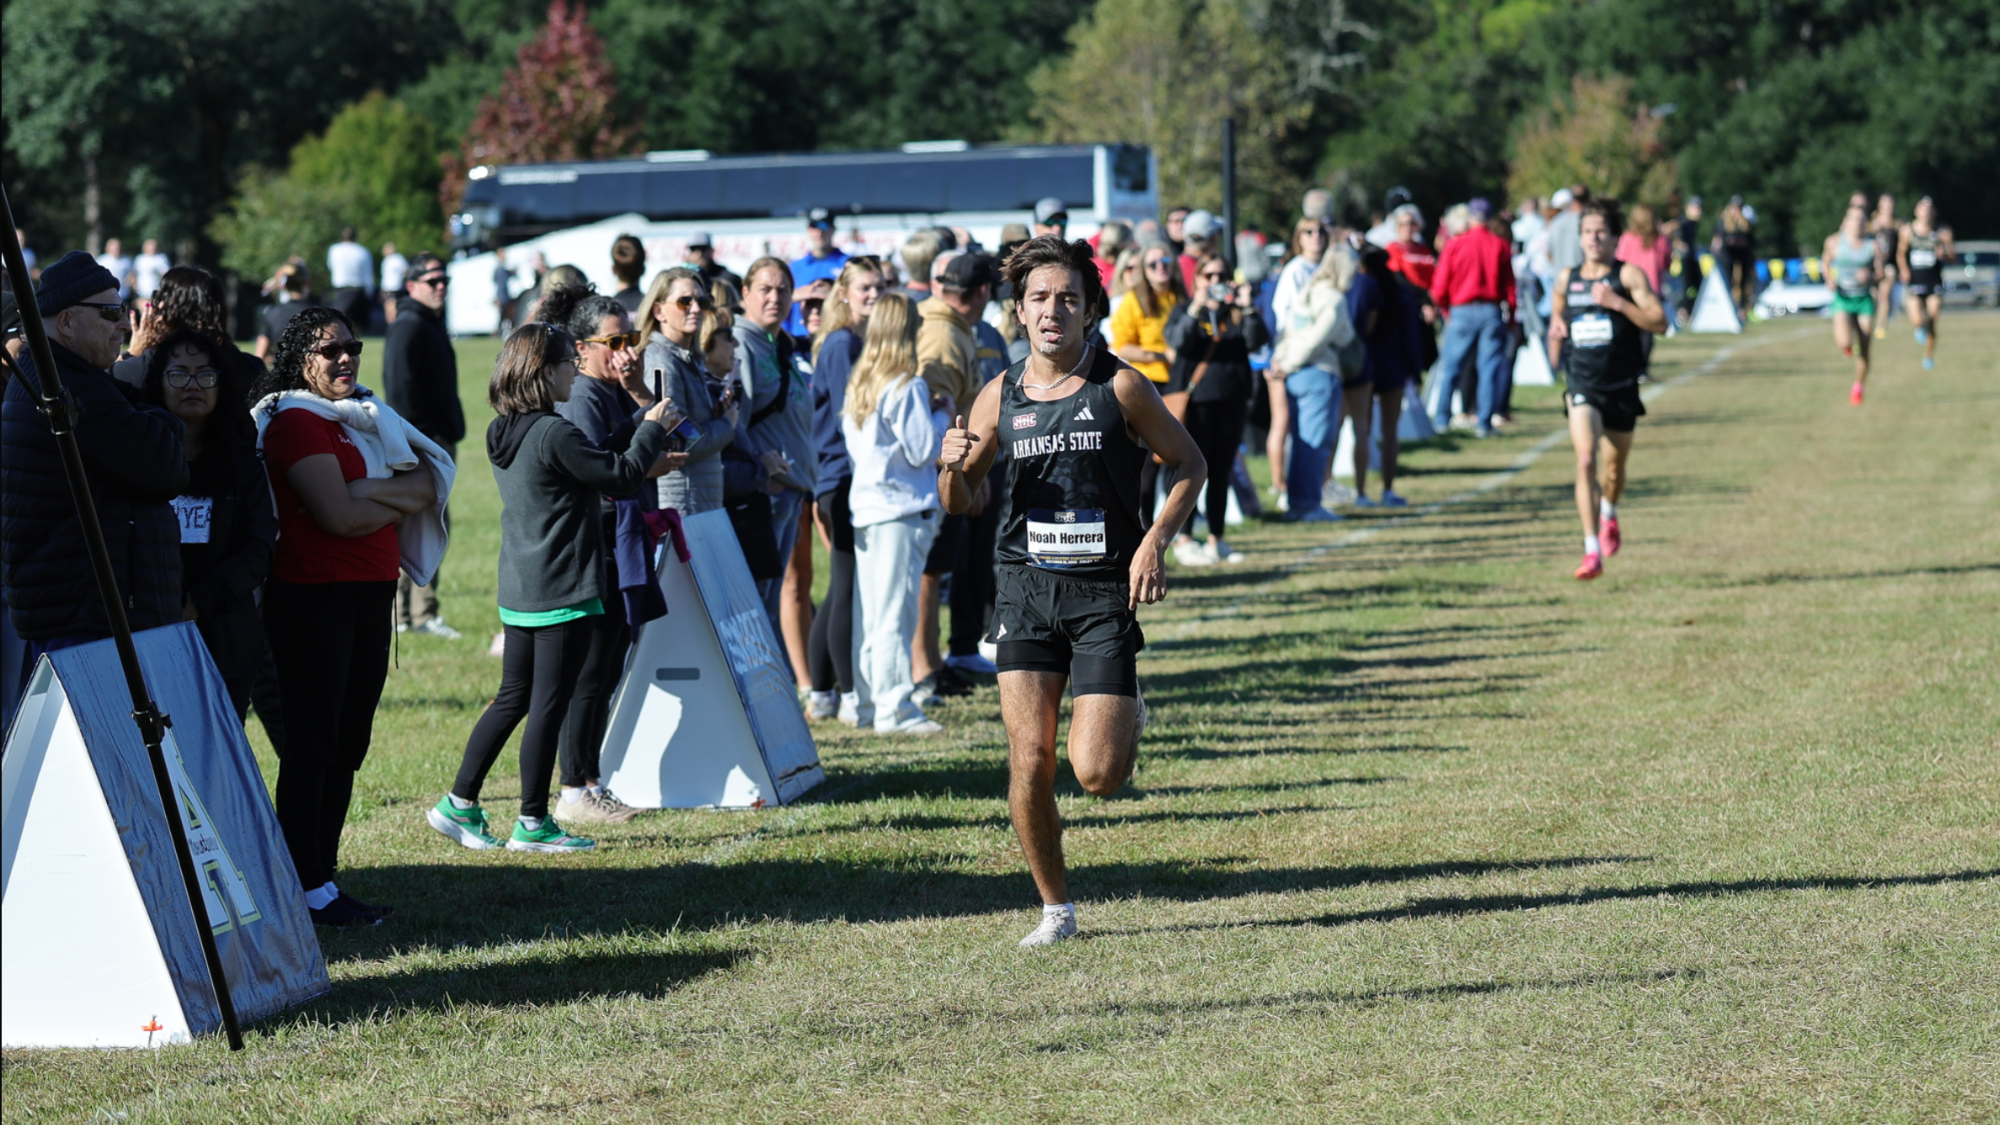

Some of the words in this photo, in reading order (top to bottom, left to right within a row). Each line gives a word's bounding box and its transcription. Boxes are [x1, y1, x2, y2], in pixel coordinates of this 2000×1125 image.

[1013, 413, 1036, 430] SBC
[1013, 433, 1065, 459] ARKANSAS
[1069, 431, 1102, 451] STATE
[1029, 531, 1056, 544] Noah
[1060, 532, 1104, 544] Herrera
